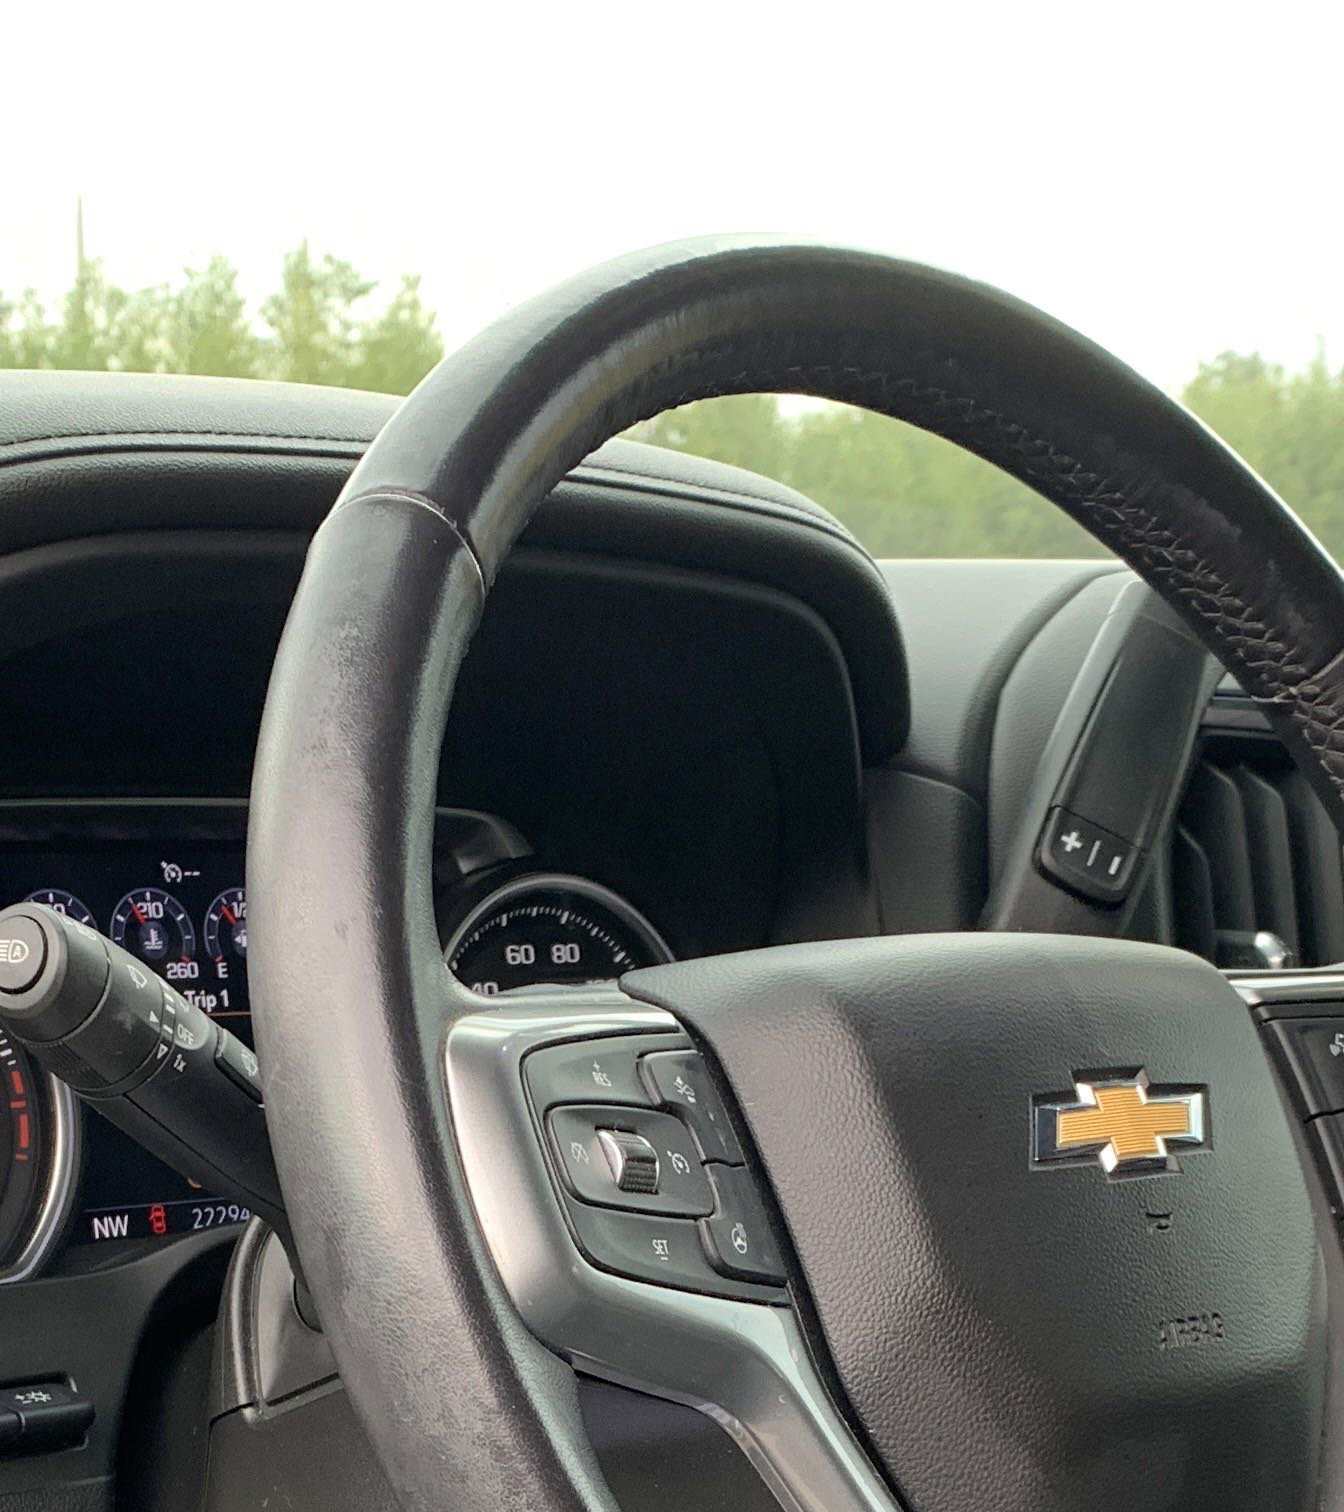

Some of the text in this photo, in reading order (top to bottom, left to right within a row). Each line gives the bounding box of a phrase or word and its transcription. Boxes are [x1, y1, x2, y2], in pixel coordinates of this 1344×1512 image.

[505, 943, 536, 966] 60
[551, 943, 581, 965] 80
[166, 962, 199, 979] 260
[218, 963, 228, 979] E
[184, 989, 229, 1012] Trip 1
[177, 1023, 194, 1045] OFF
[173, 1054, 187, 1072] 1x
[93, 1214, 129, 1239] NW
[652, 1239, 669, 1255] SET
